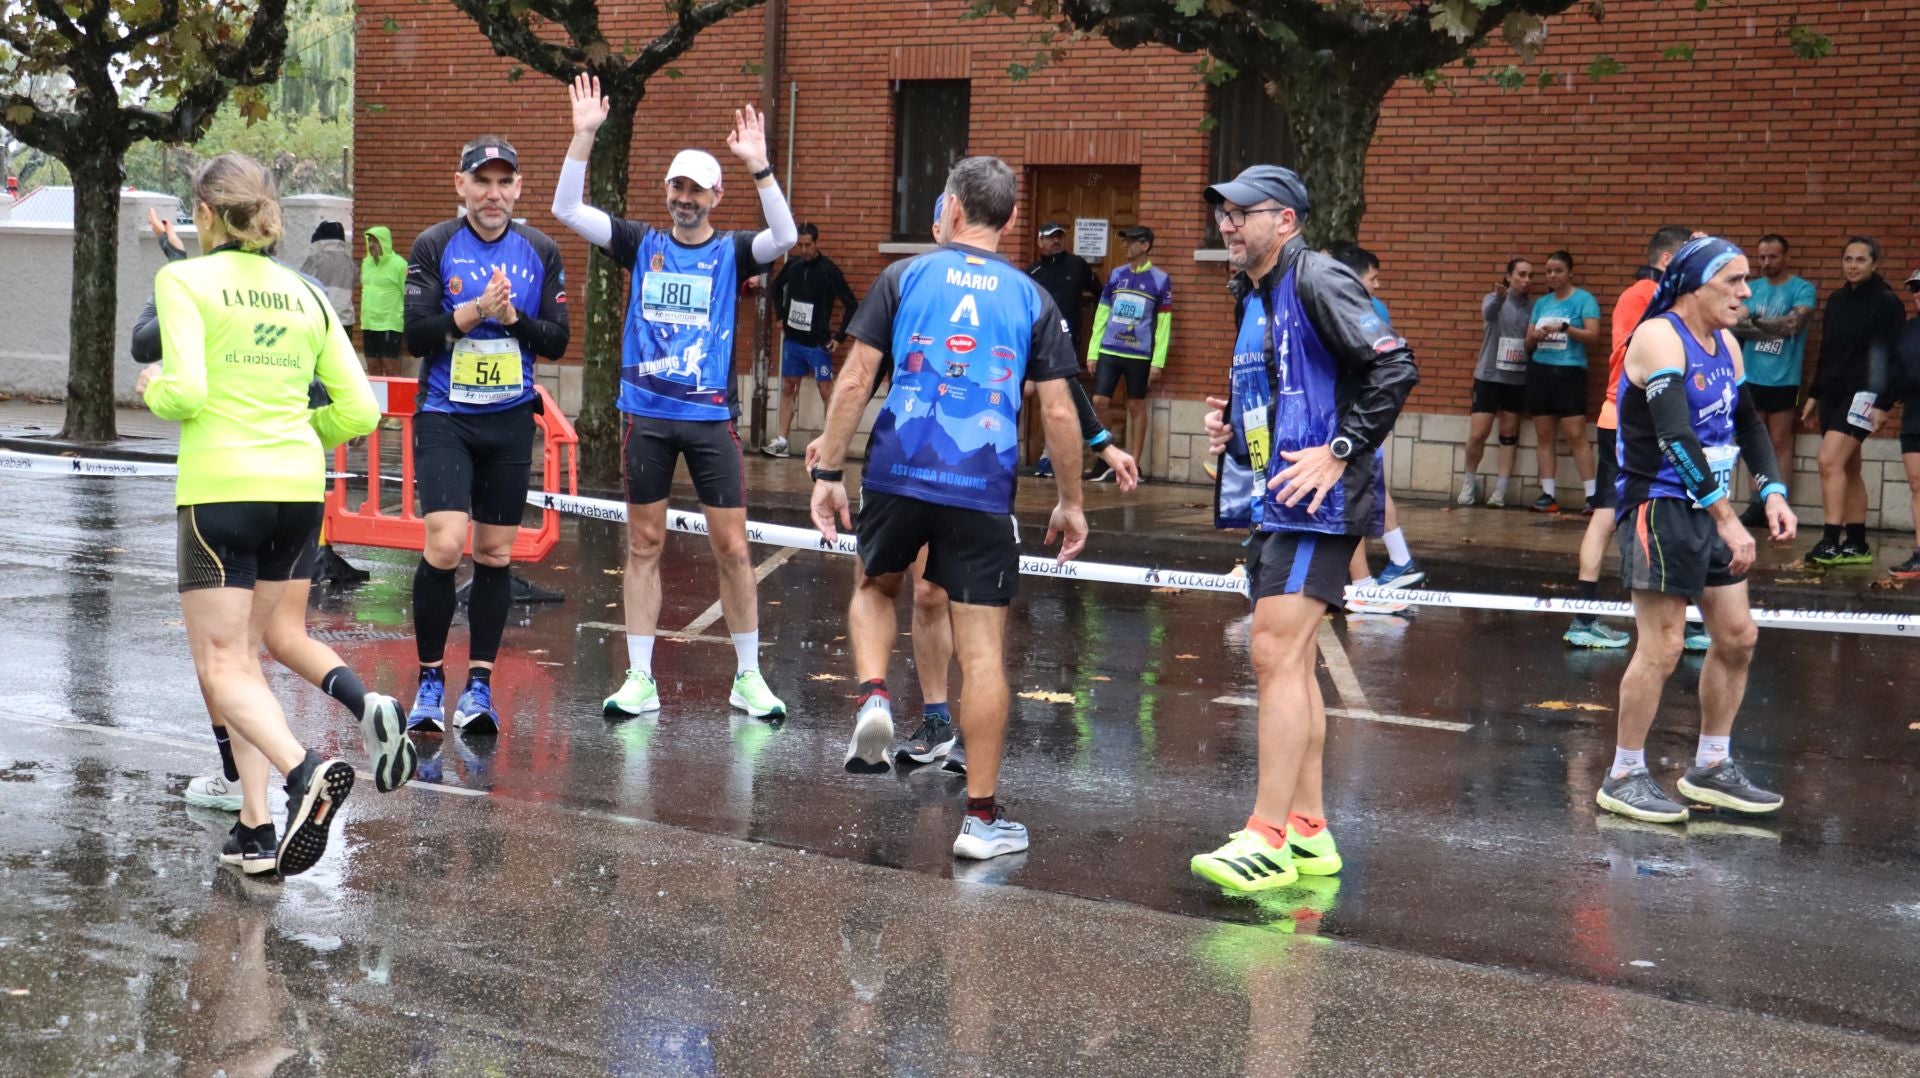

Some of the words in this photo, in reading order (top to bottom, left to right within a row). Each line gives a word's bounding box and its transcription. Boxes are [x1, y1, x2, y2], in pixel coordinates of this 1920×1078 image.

[946, 267, 999, 292] MARIO
[222, 288, 245, 307] LA
[248, 289, 305, 314] ROBLA
[661, 282, 692, 306] 180
[665, 311, 697, 321] HYUNDAI
[1118, 303, 1136, 317] 209
[225, 349, 240, 364] EL
[638, 355, 680, 375] RUNNING
[476, 361, 501, 385] 54
[478, 392, 511, 400] HYUNDAI
[890, 463, 937, 482] ASTORGA
[939, 471, 987, 490] RUNNING
[560, 500, 625, 521] kutxabank
[1167, 572, 1248, 590] kutxaban
[1355, 585, 1453, 604] kutxabank
[1561, 595, 1634, 612] kutxab
